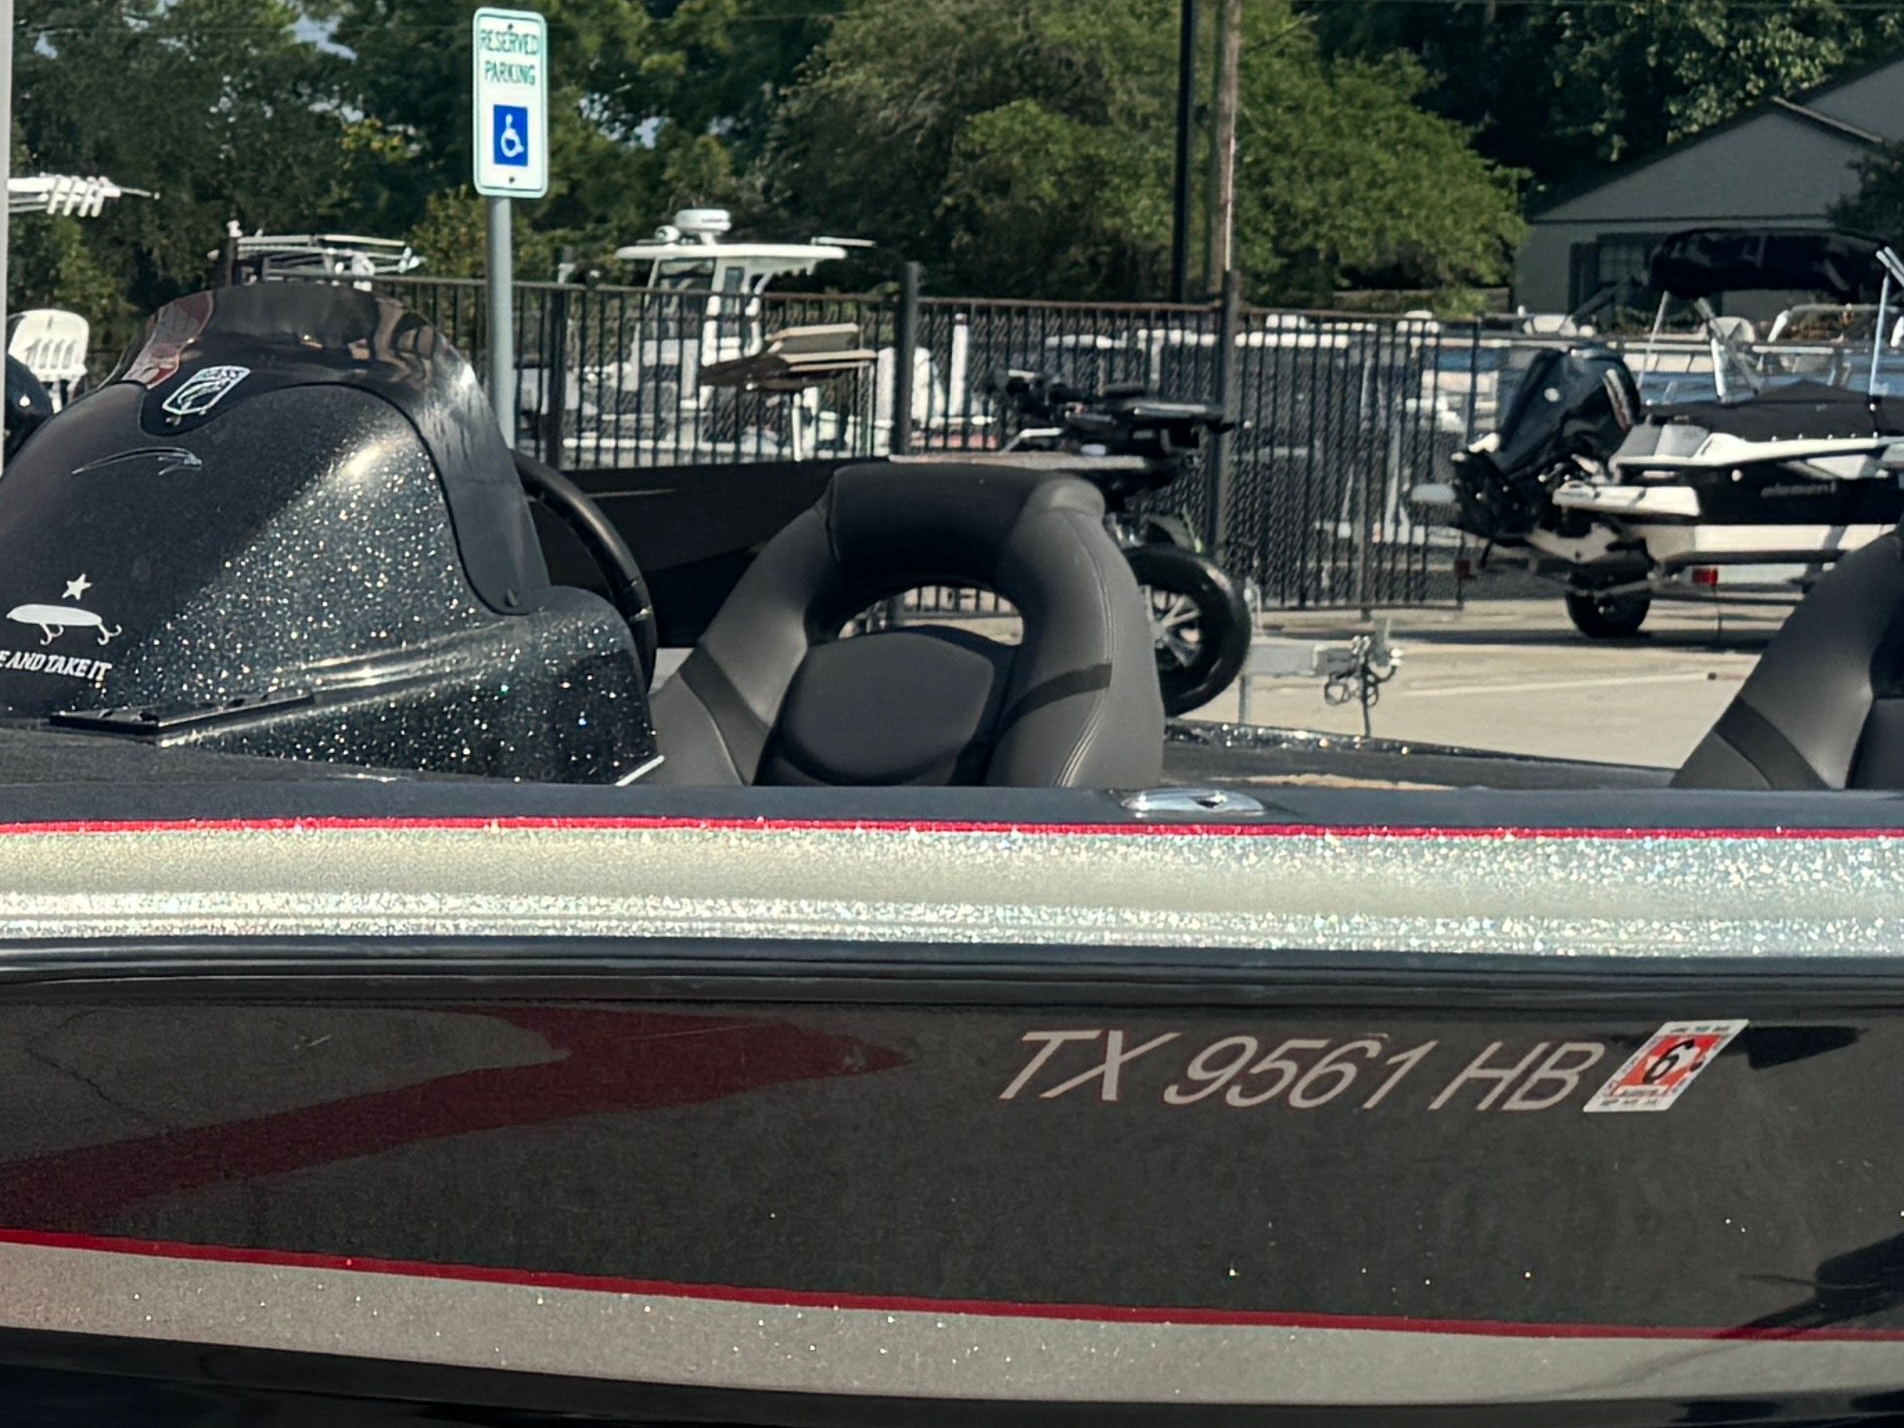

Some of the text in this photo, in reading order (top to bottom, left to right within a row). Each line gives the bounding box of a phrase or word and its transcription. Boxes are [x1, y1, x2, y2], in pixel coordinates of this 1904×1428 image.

[480, 28, 540, 55] RESERVED
[484, 59, 536, 86] PARKING
[5, 651, 46, 671] AND
[43, 654, 92, 677] TAKE
[87, 660, 113, 681] IT
[999, 1029, 1607, 1111] TX 9561 HB
